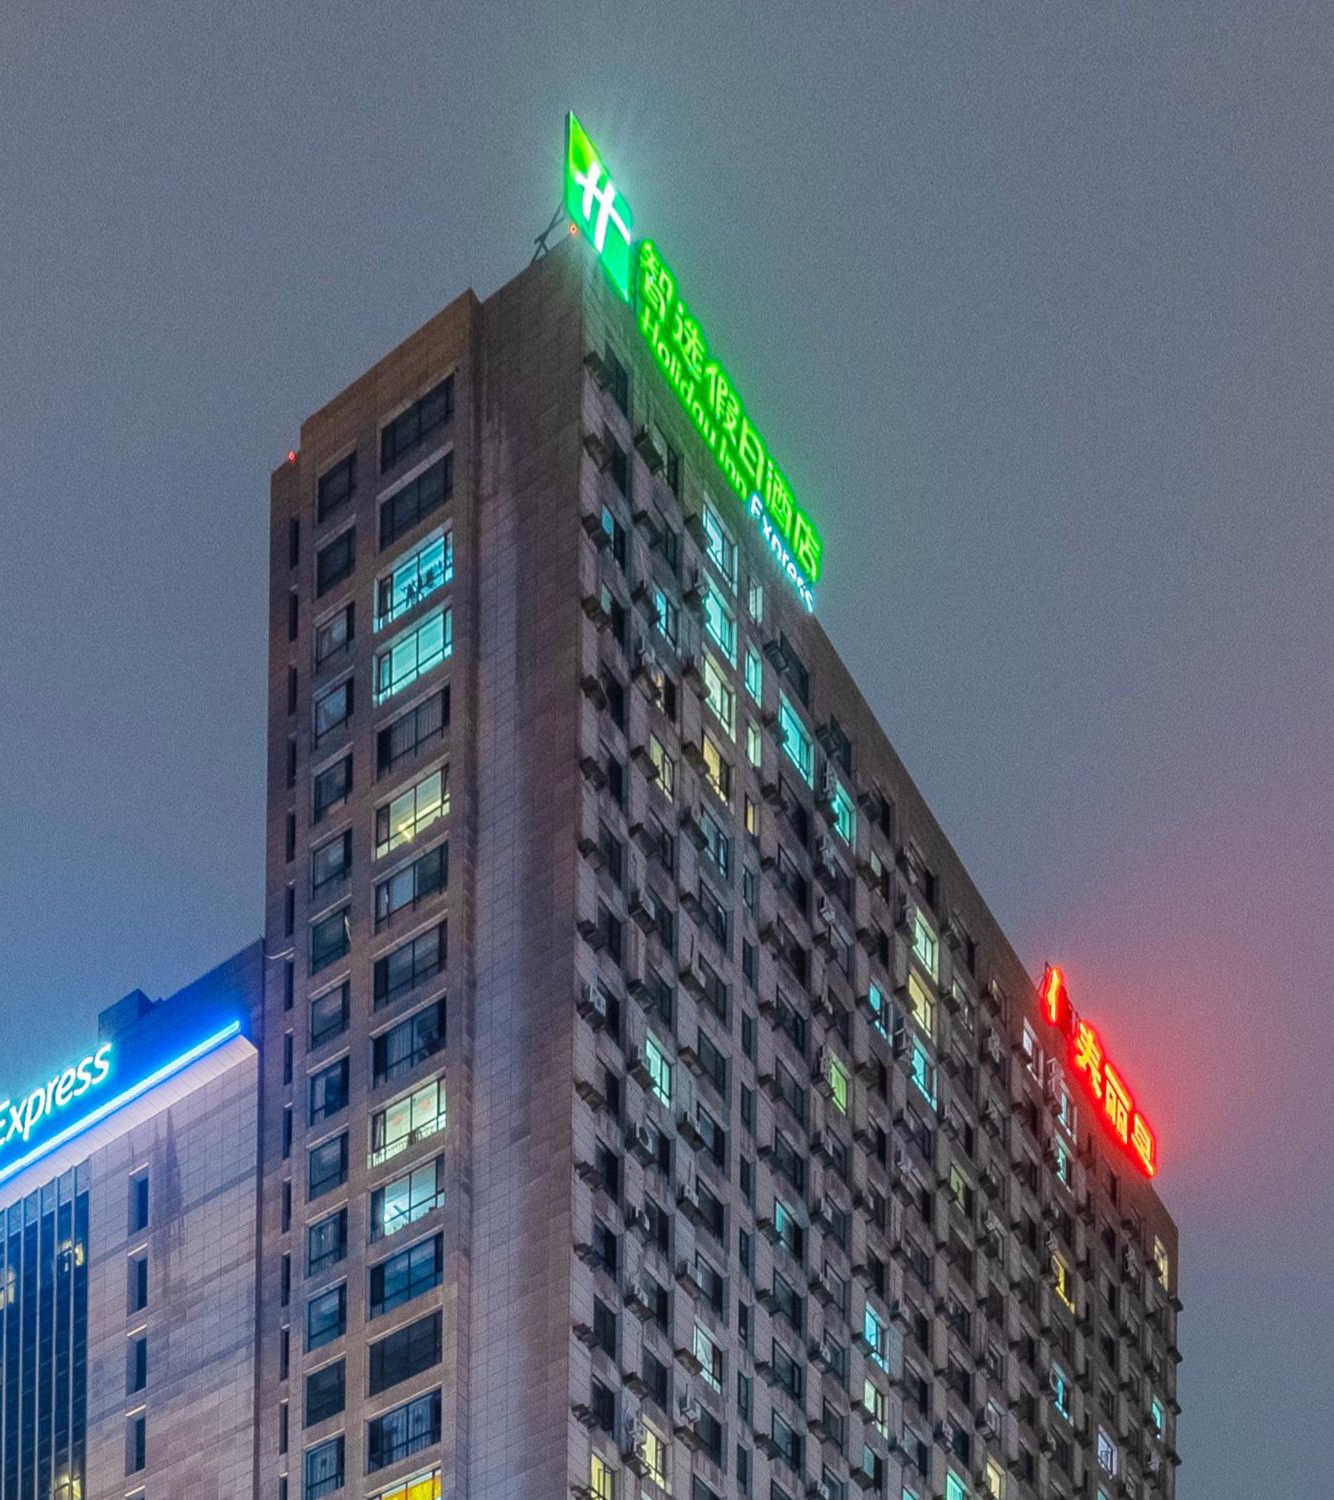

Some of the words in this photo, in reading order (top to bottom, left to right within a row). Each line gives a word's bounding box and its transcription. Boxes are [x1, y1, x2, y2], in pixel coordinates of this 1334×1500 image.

[637, 240, 822, 580] 智选假日酒店
